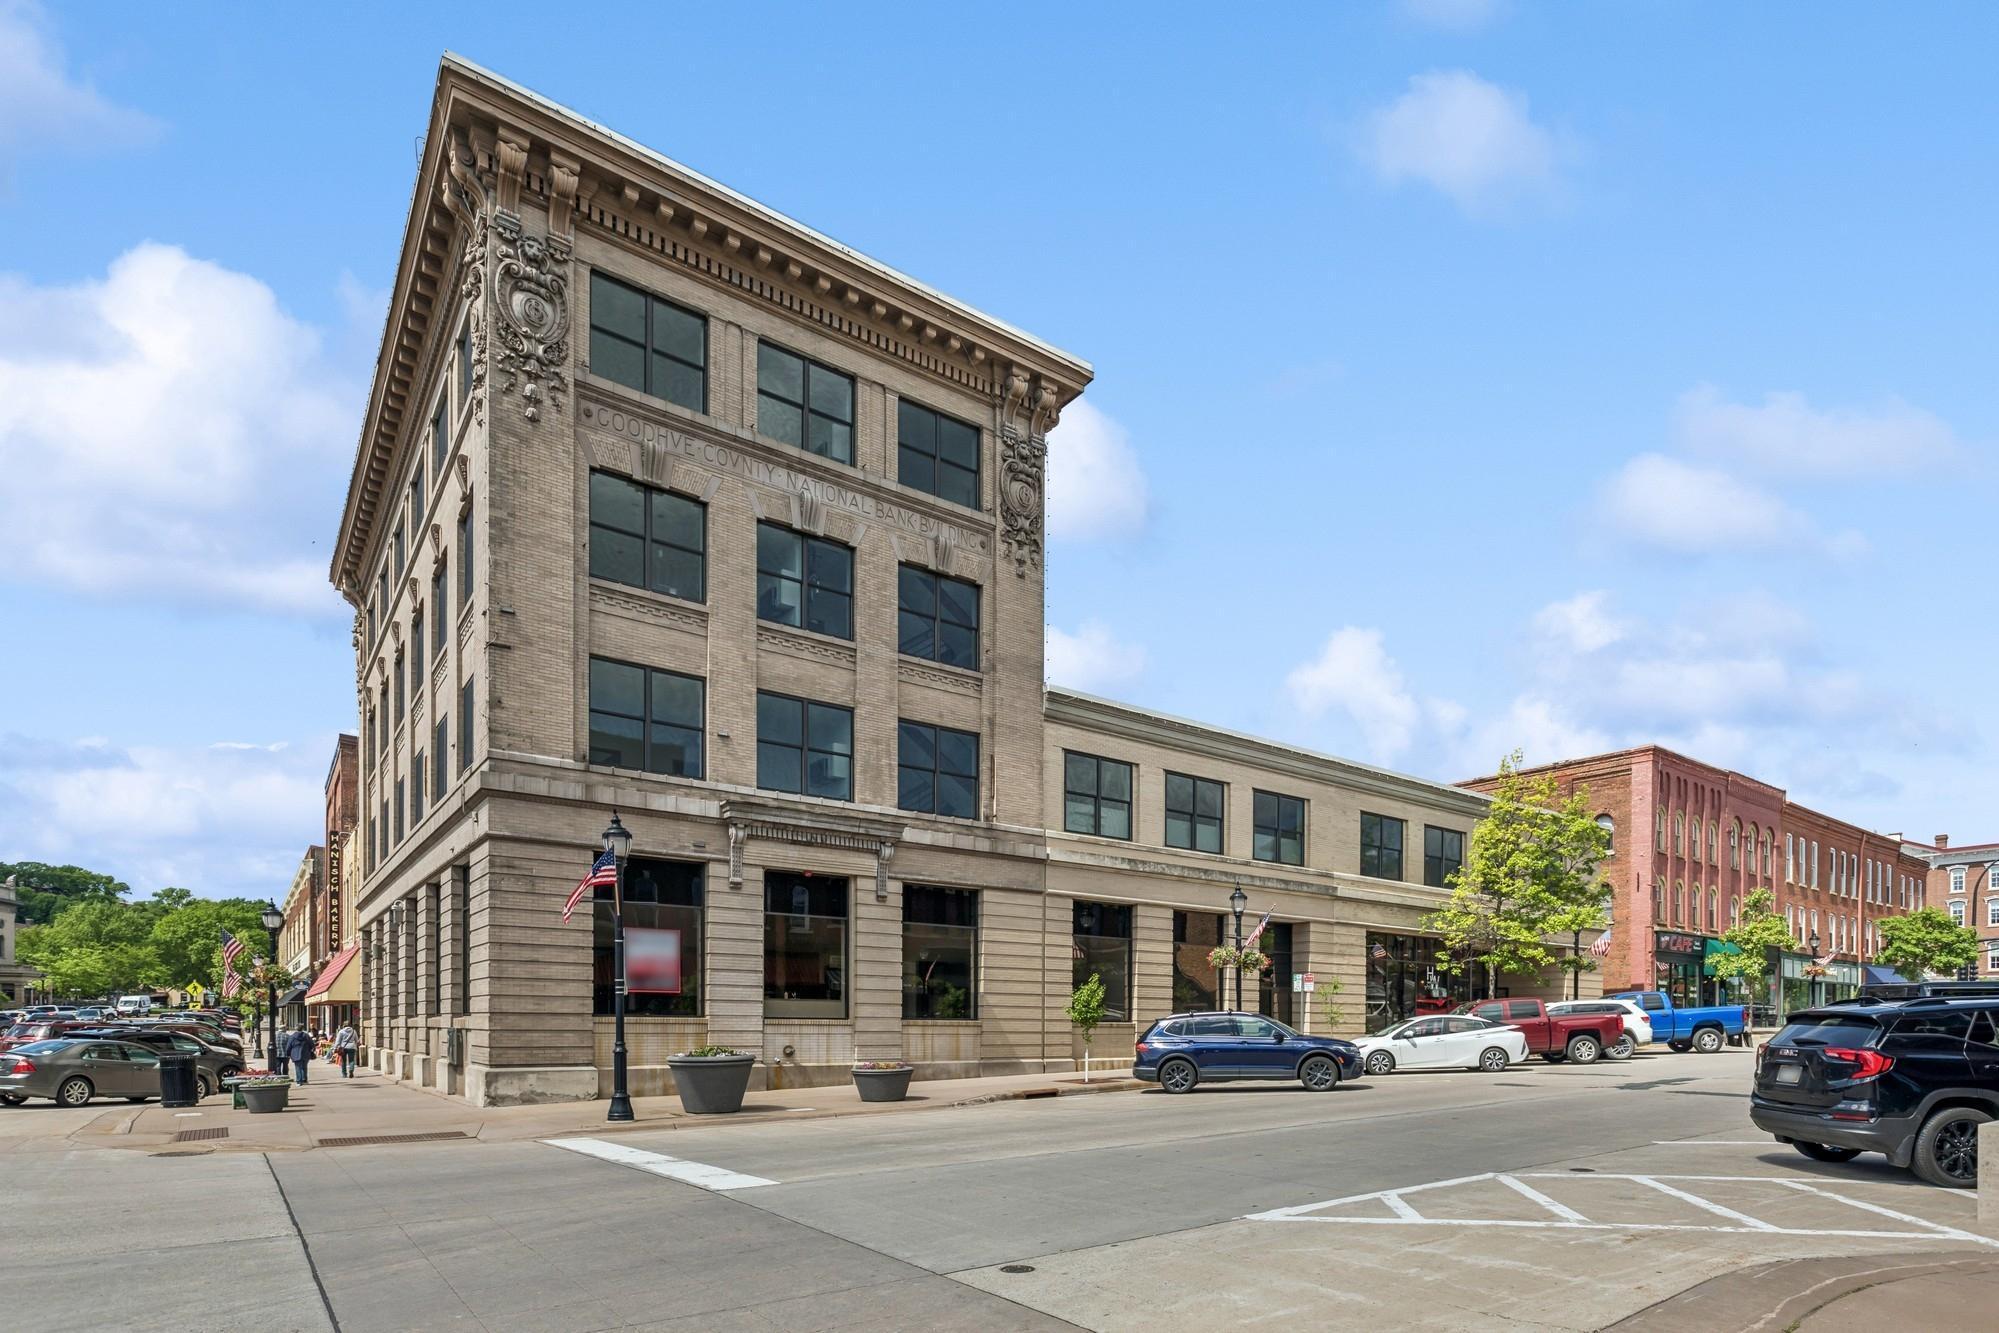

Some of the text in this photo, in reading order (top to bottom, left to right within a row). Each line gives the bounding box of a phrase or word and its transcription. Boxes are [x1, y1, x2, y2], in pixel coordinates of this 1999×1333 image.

[703, 443, 776, 482] COVNTY
[786, 473, 871, 515] NATIONAL
[875, 503, 915, 530] BANK
[330, 834, 339, 948] HANISCH BAKERY
